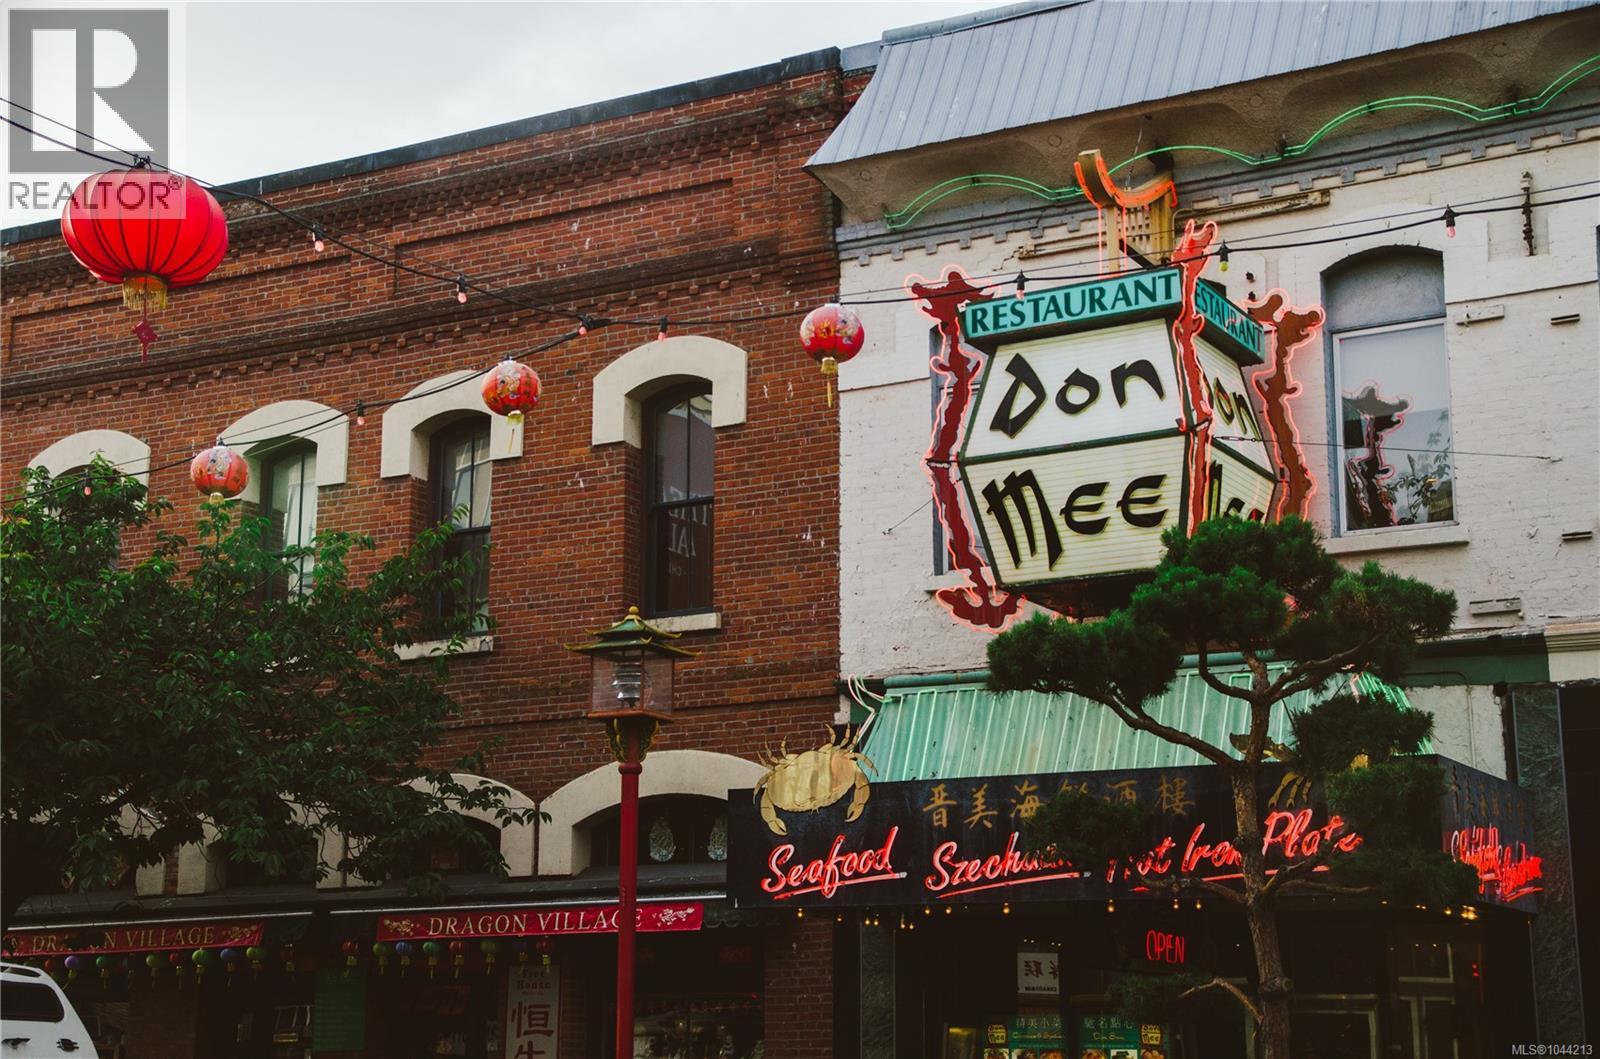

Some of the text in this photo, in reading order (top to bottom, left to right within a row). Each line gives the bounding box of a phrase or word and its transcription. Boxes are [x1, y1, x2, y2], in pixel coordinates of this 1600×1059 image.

[970, 272, 1180, 336] RESTAURANT
[1195, 280, 1262, 354] ESTAURANT
[989, 352, 1167, 439] Don
[1203, 376, 1261, 442] on
[761, 826, 899, 898] Seafood
[925, 832, 1073, 891] Szechu
[1106, 836, 1176, 883] ot
[126, 926, 215, 947] VILLAGE
[428, 913, 527, 935] DRAGON
[1146, 929, 1186, 964] OPEN
